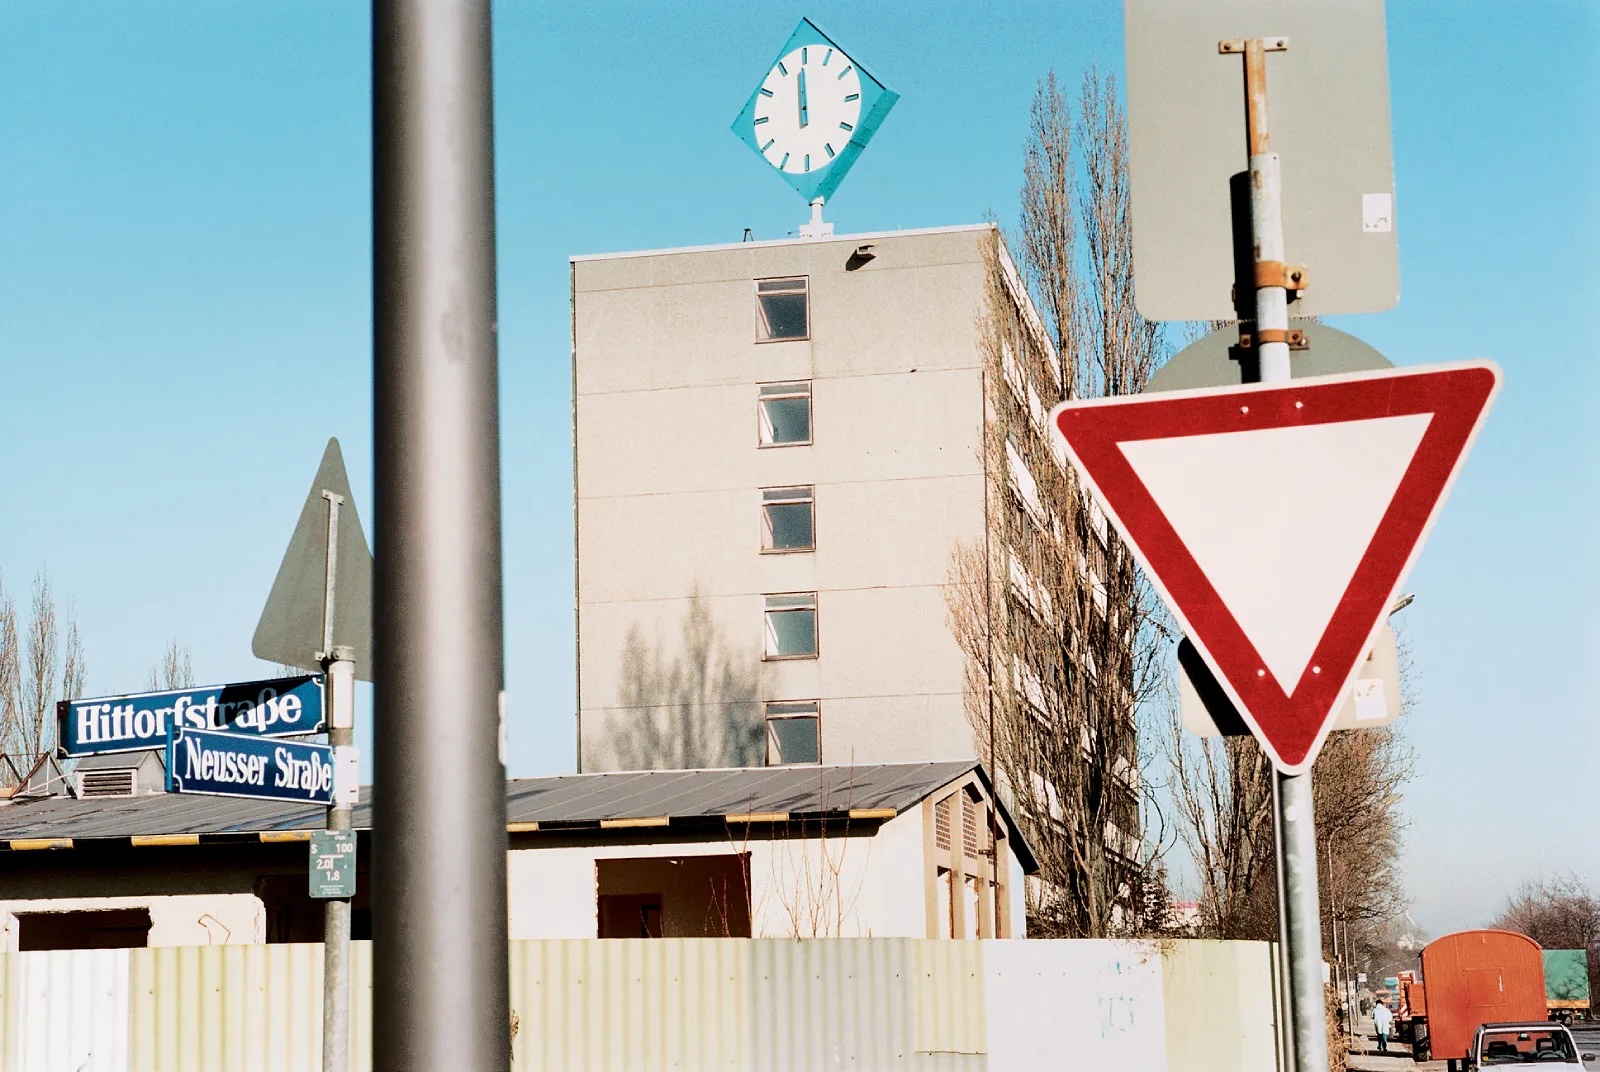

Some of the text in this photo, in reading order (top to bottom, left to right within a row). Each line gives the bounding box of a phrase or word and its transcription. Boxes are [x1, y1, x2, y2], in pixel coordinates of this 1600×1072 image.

[76, 687, 302, 745] Hittorfstraße
[184, 735, 332, 798] Neusser Straße
[335, 842, 353, 854] 100
